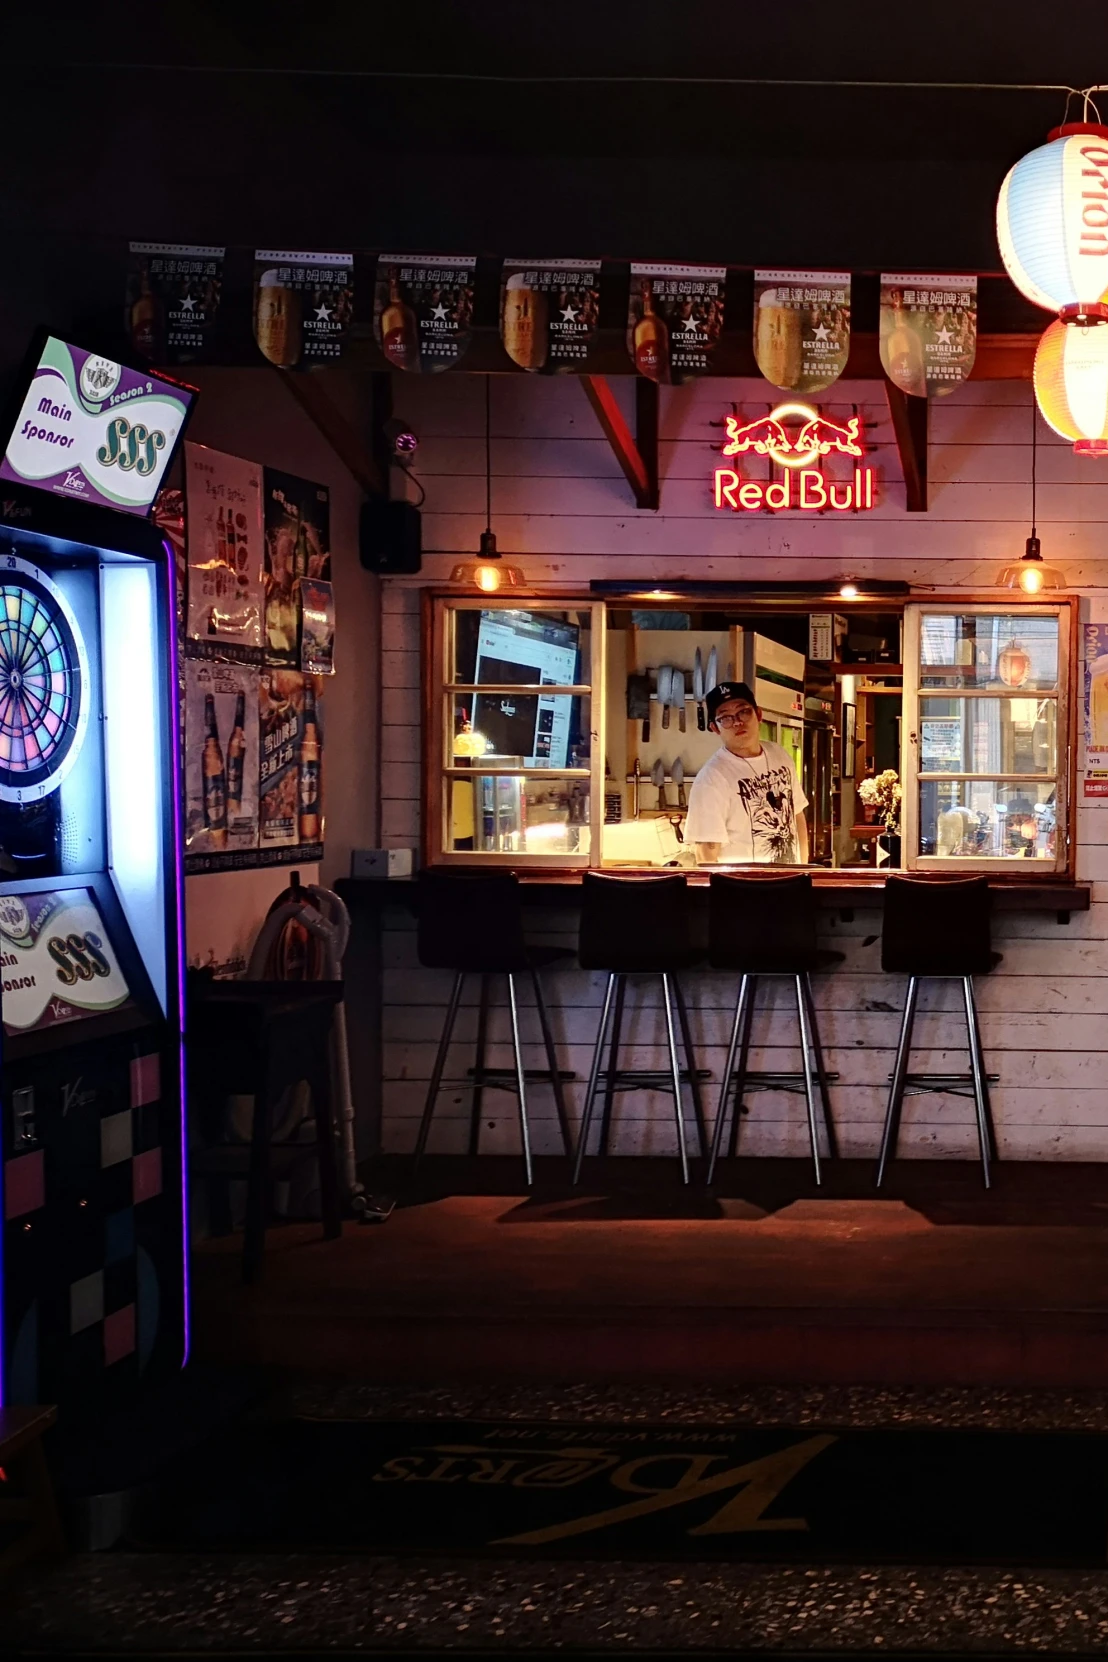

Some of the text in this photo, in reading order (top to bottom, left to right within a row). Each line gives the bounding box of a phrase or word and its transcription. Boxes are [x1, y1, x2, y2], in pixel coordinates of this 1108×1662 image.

[278, 267, 348, 285] 星達姆啤酒
[399, 267, 469, 284] 星達姆啤酒
[524, 270, 594, 286] 星達姆啤酒
[652, 280, 719, 296] 星達姆啤酒
[776, 287, 845, 303] 星達姆啤酒
[903, 290, 971, 307] 星達姆啤酒
[168, 311, 206, 321] ESTRELLA
[303, 321, 342, 330] ESTRELLA
[420, 320, 459, 330] ESTRELLA
[549, 322, 588, 332] ESTRELLA
[671, 332, 709, 341] ESTRELLA
[802, 340, 840, 350] ESTRELLA
[925, 344, 963, 353] ESTRELLA
[110, 385, 144, 406] Season
[146, 382, 153, 393] 2
[37, 397, 72, 421] Main
[21, 420, 75, 448] Sponsor
[714, 467, 873, 510] Red Bull
[7, 556, 17, 568] 20
[719, 685, 730, 695] LA
[0, 951, 19, 967] ain
